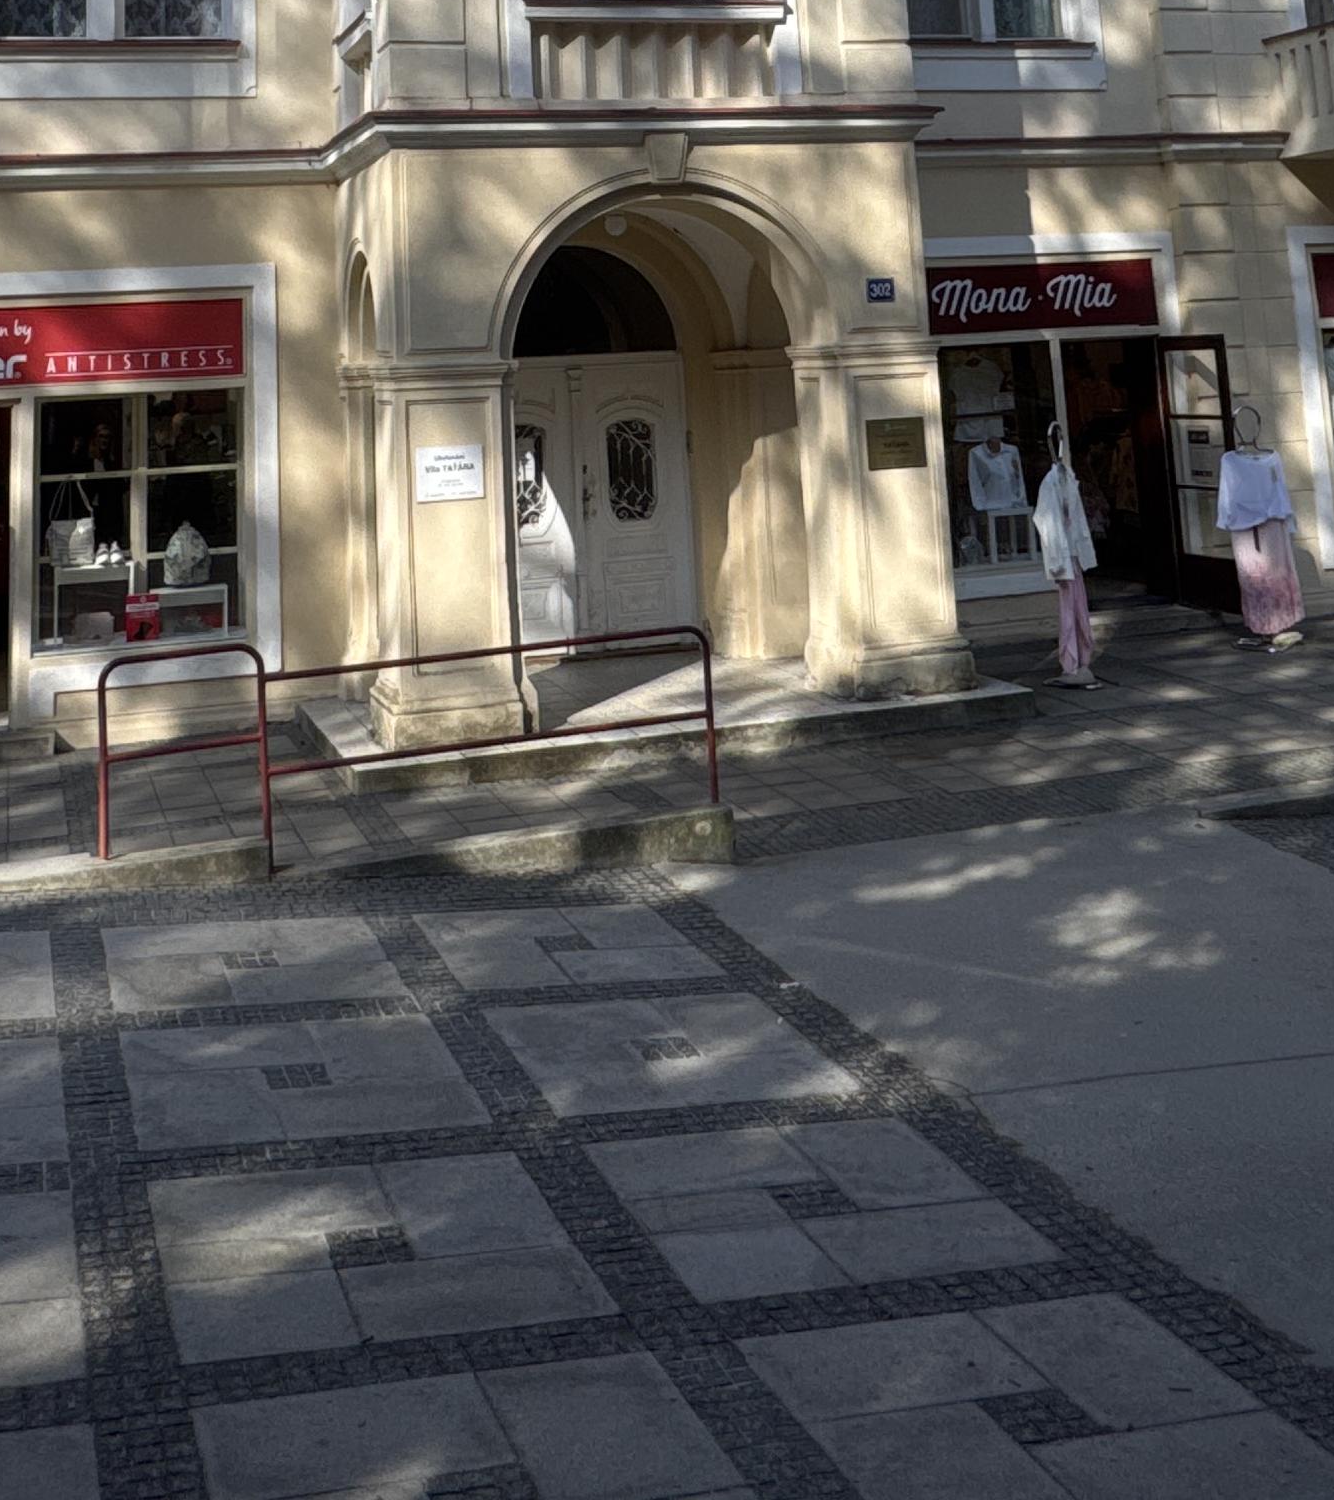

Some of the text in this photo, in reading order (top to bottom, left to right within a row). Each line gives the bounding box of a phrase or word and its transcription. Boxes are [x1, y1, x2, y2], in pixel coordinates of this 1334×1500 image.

[869, 282, 892, 298] 302
[931, 273, 1117, 324] Mona Mia
[13, 319, 33, 344] by
[46, 349, 227, 374] ANTISTRESS
